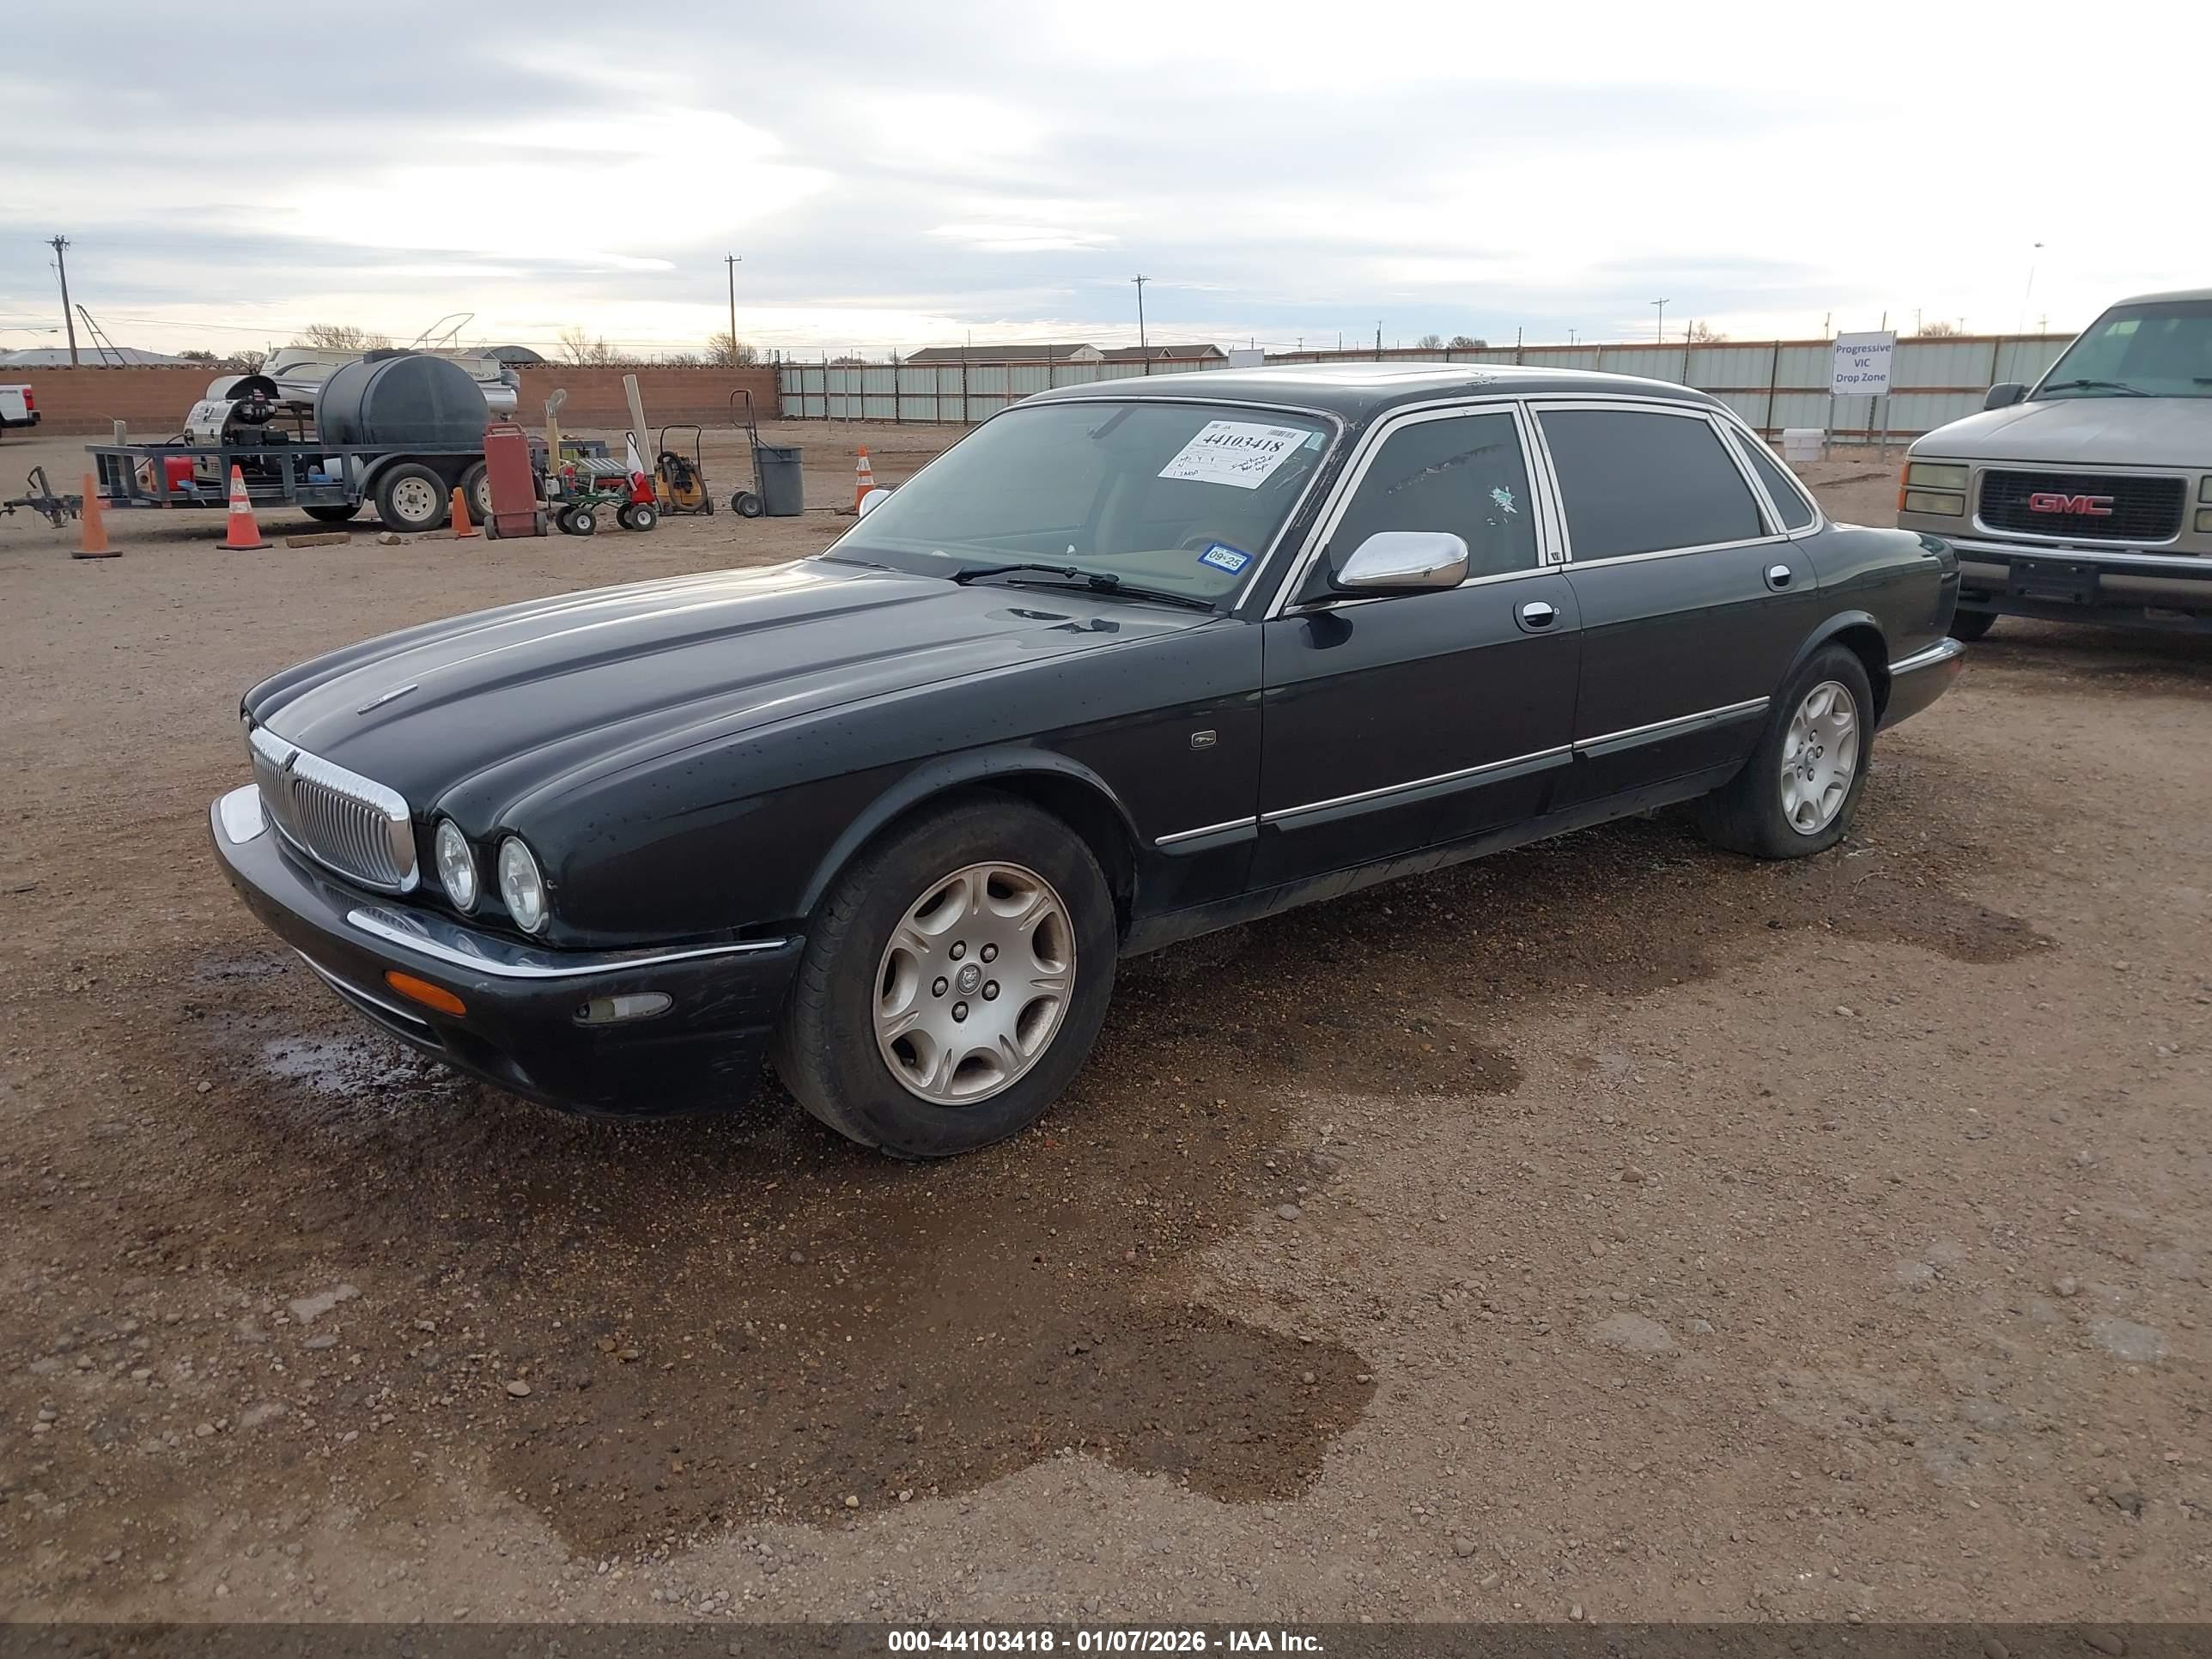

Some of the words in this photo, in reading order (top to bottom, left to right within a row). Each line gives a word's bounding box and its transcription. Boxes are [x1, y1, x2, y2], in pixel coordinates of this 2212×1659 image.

[1836, 343, 1891, 356] Progressive
[1855, 358, 1870, 368] VIC
[1836, 374, 1859, 384] Drop
[1862, 373, 1886, 382] Zone
[1203, 433, 1284, 453] 44103418
[2028, 493, 2114, 515] GMC
[1209, 551, 1224, 561] 09
[1225, 556, 1242, 567] 25
